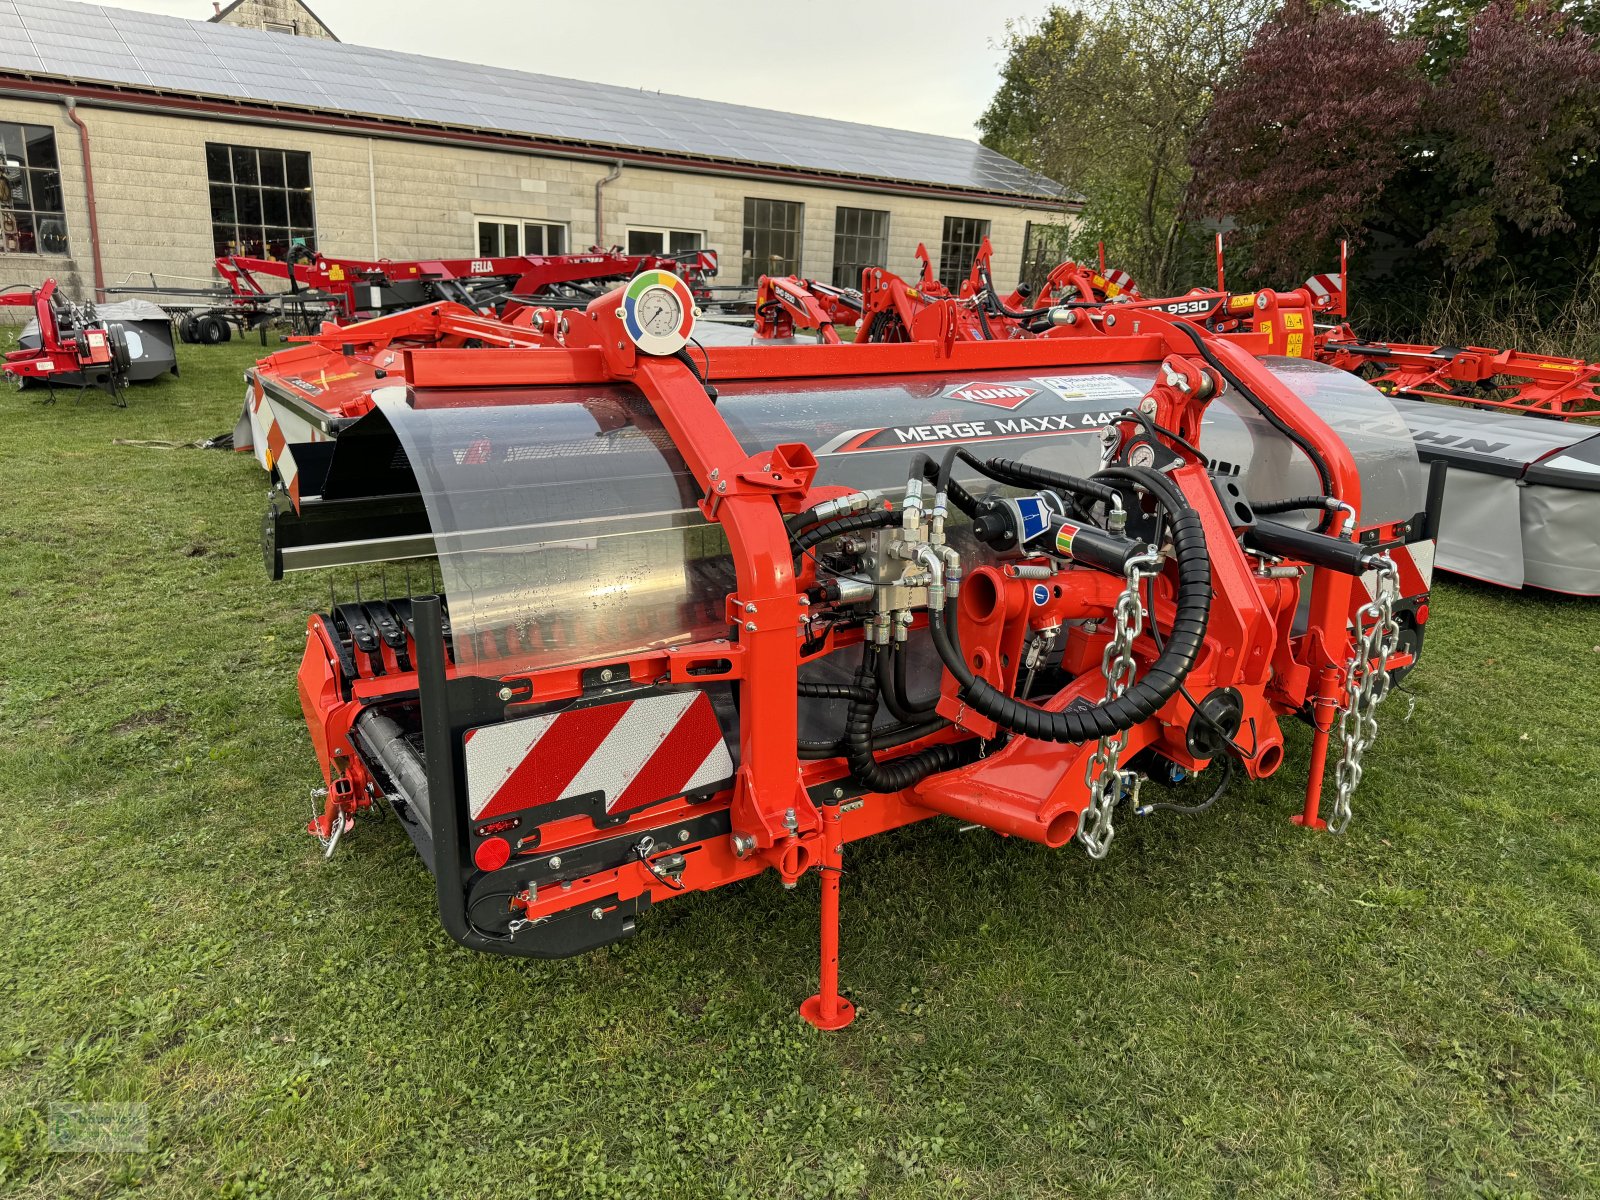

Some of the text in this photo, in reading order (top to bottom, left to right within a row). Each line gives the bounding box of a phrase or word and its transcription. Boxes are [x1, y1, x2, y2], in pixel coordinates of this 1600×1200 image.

[470, 260, 494, 274] FELLA
[1167, 300, 1209, 314] 9530
[960, 387, 1027, 401] KUHN
[894, 421, 991, 442] MERGE
[996, 415, 1076, 433] MAXX
